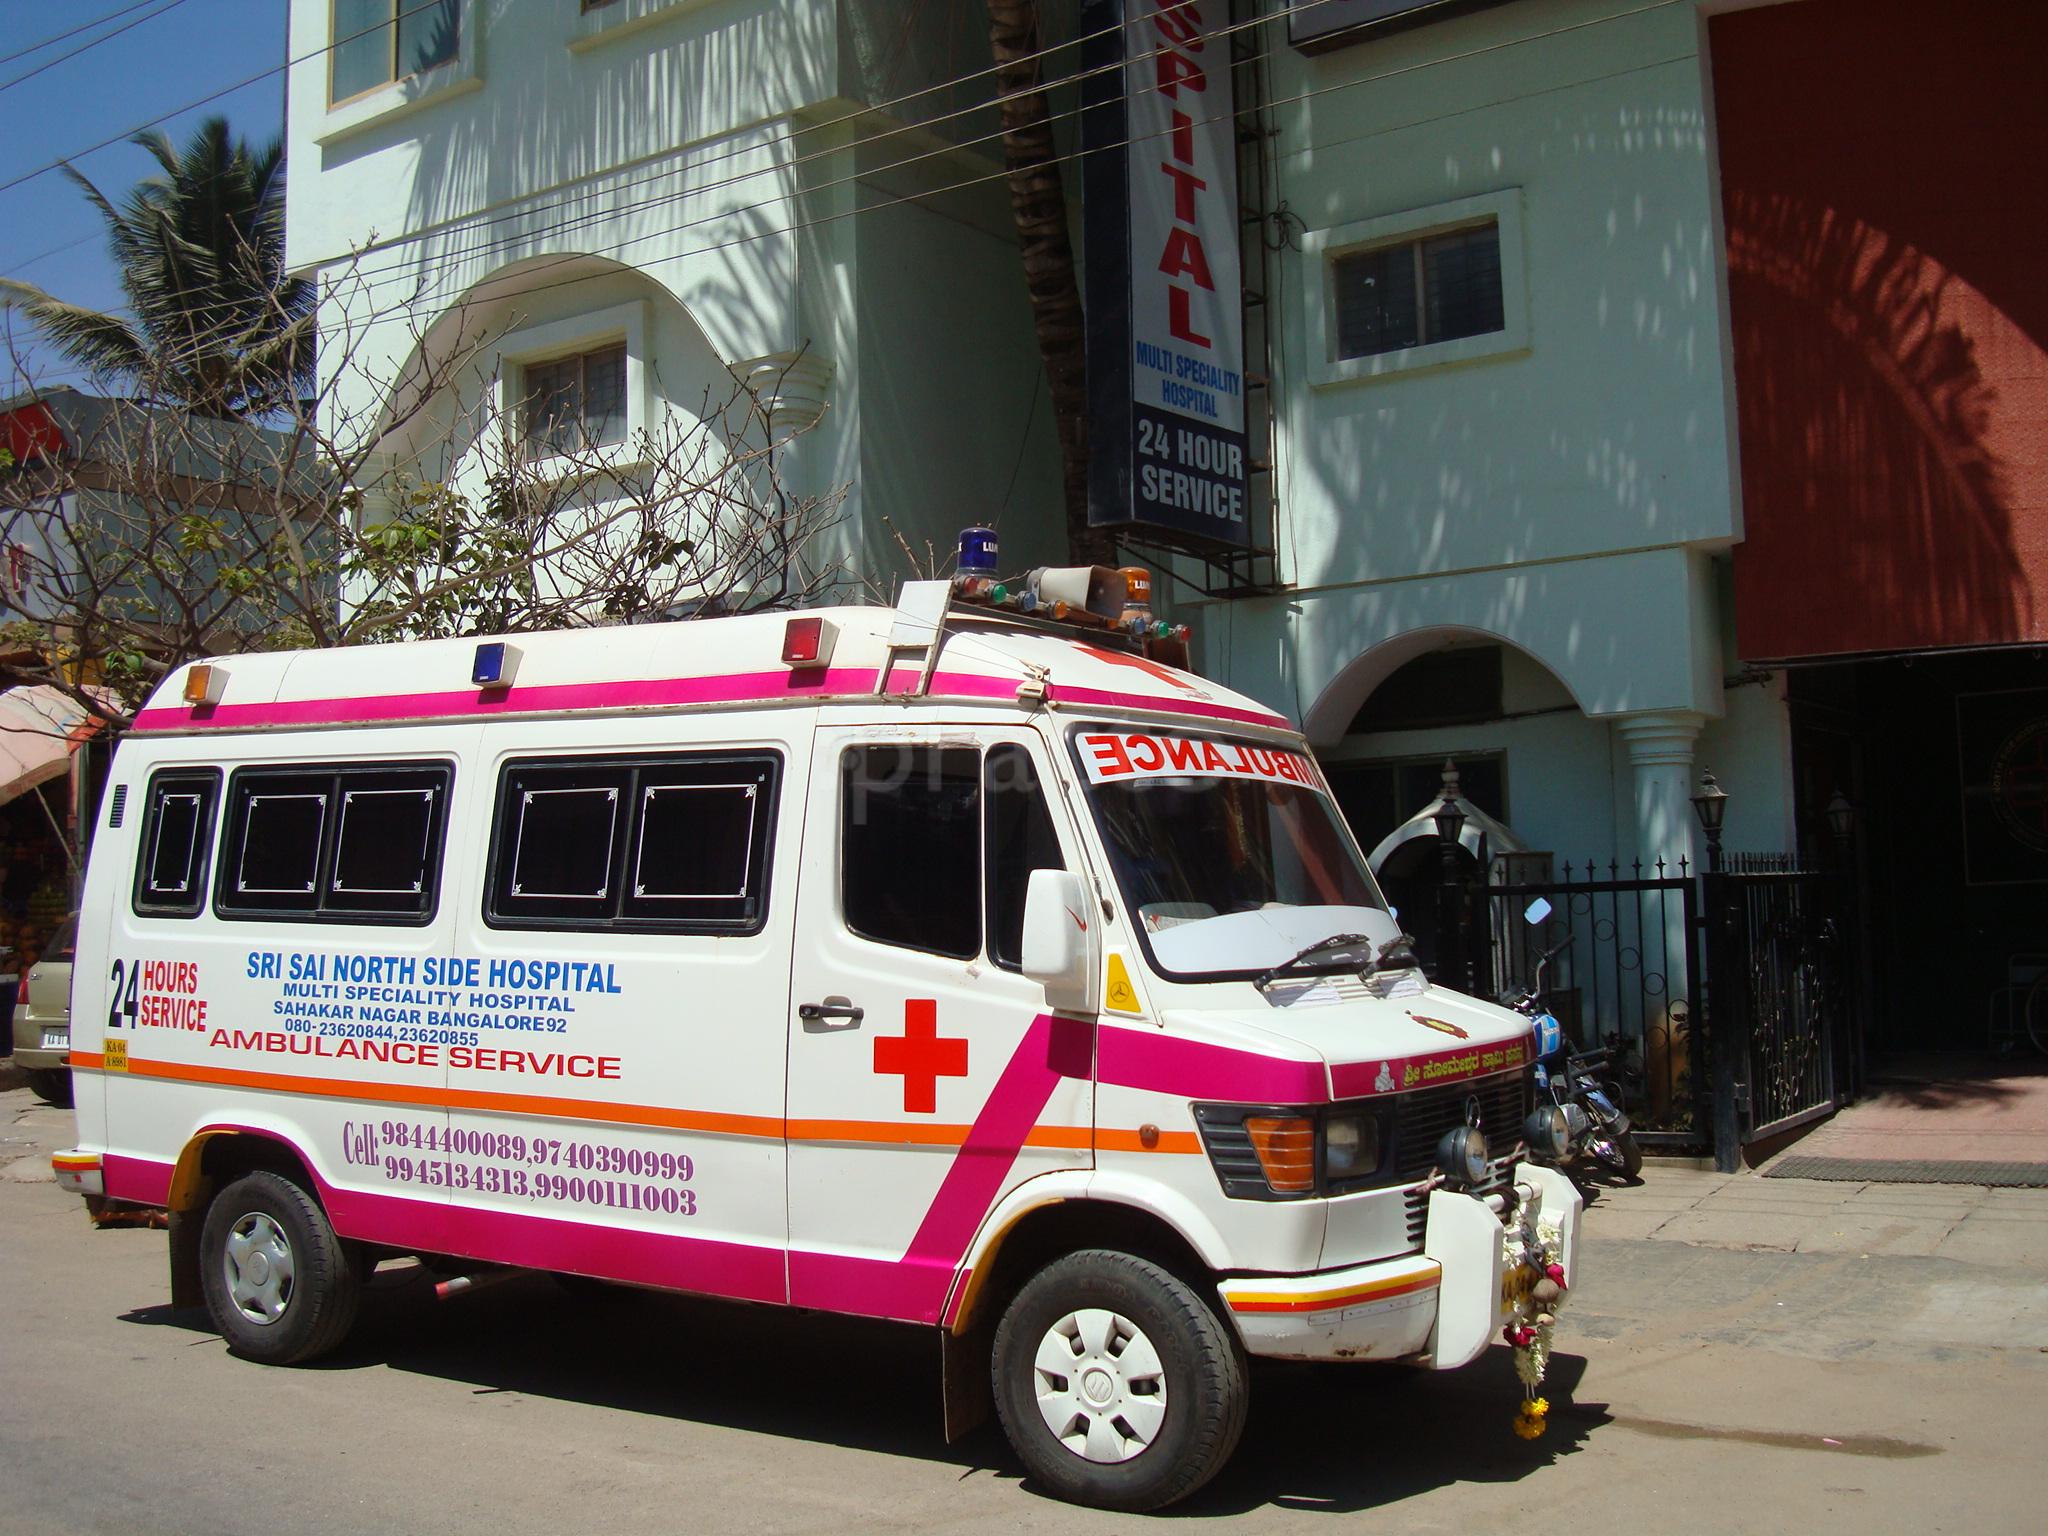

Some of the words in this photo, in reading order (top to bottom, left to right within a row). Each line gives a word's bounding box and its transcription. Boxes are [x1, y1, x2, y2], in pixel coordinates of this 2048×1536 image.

[1136, 341, 1172, 375] MULTI
[1176, 355, 1240, 396] SPECIALITY
[1162, 380, 1218, 418] HOSPITAL
[1138, 419, 1170, 460] 24
[1177, 429, 1243, 480] HOUR
[1142, 464, 1242, 522] SERVICE
[108, 958, 140, 1030] 24
[143, 960, 198, 994] HOURS
[247, 952, 283, 979] SRI
[289, 953, 326, 981] SAI
[333, 955, 416, 985] NORTH
[422, 957, 481, 986] SIDE
[489, 959, 622, 994] HOSPITAL
[141, 995, 207, 1032] SERVICE
[273, 1000, 354, 1020] SAHAKAR
[360, 1006, 422, 1025] NAGAR
[283, 982, 339, 999] MULTI
[345, 986, 461, 1007] SPECIALITY
[469, 993, 576, 1012] HOSPITAL
[106, 1040, 117, 1053] KA
[209, 1029, 440, 1067] AMBULANCE
[449, 1046, 622, 1079] SERVICE
[343, 1121, 380, 1166] Cell:
[382, 1120, 695, 1182] 9844400089,9740390999
[385, 1155, 697, 1216] 9945134313,9900111003
